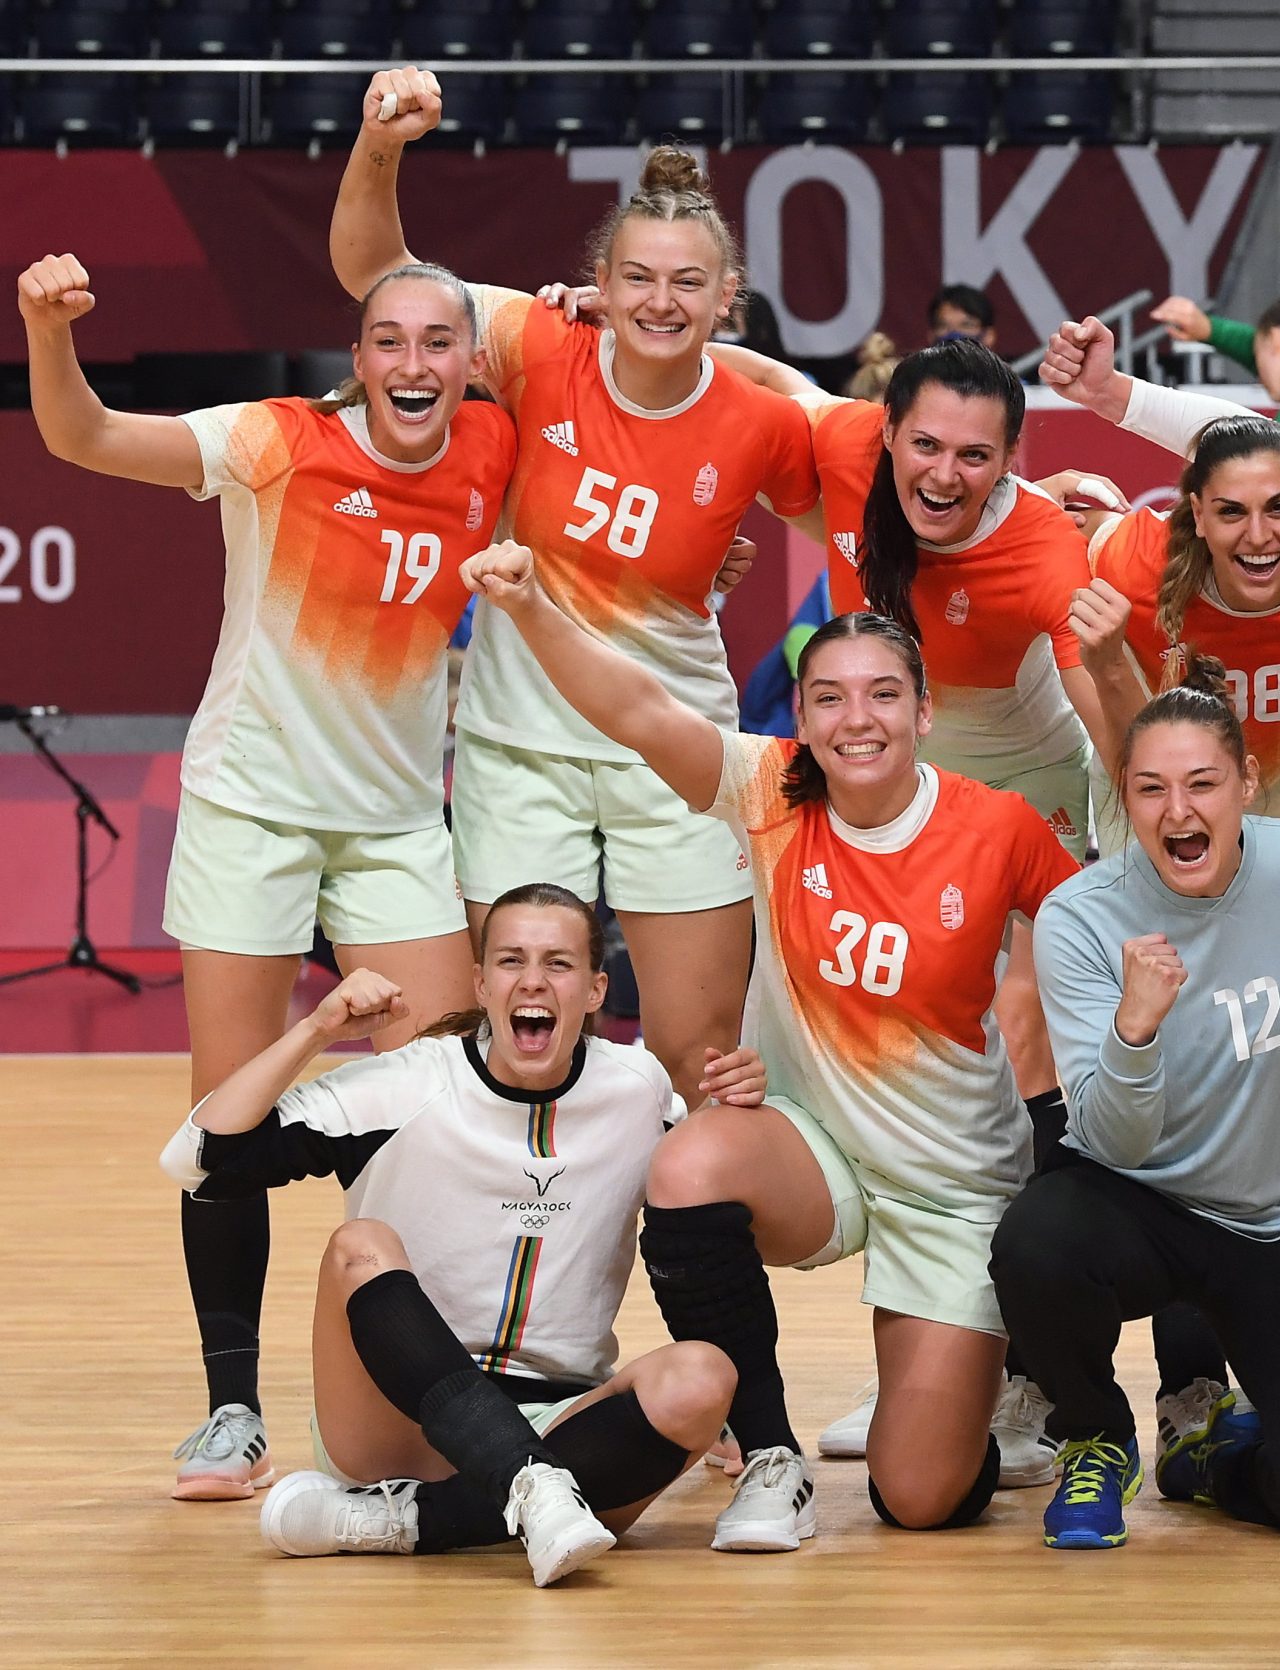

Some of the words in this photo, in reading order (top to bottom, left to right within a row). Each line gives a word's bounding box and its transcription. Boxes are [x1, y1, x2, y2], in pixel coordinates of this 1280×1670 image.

[541, 426, 580, 458] adidas
[333, 500, 379, 520] adidas
[563, 466, 660, 560] 58
[379, 529, 442, 604] 19
[1048, 823, 1078, 836] didas
[818, 909, 910, 997] 38
